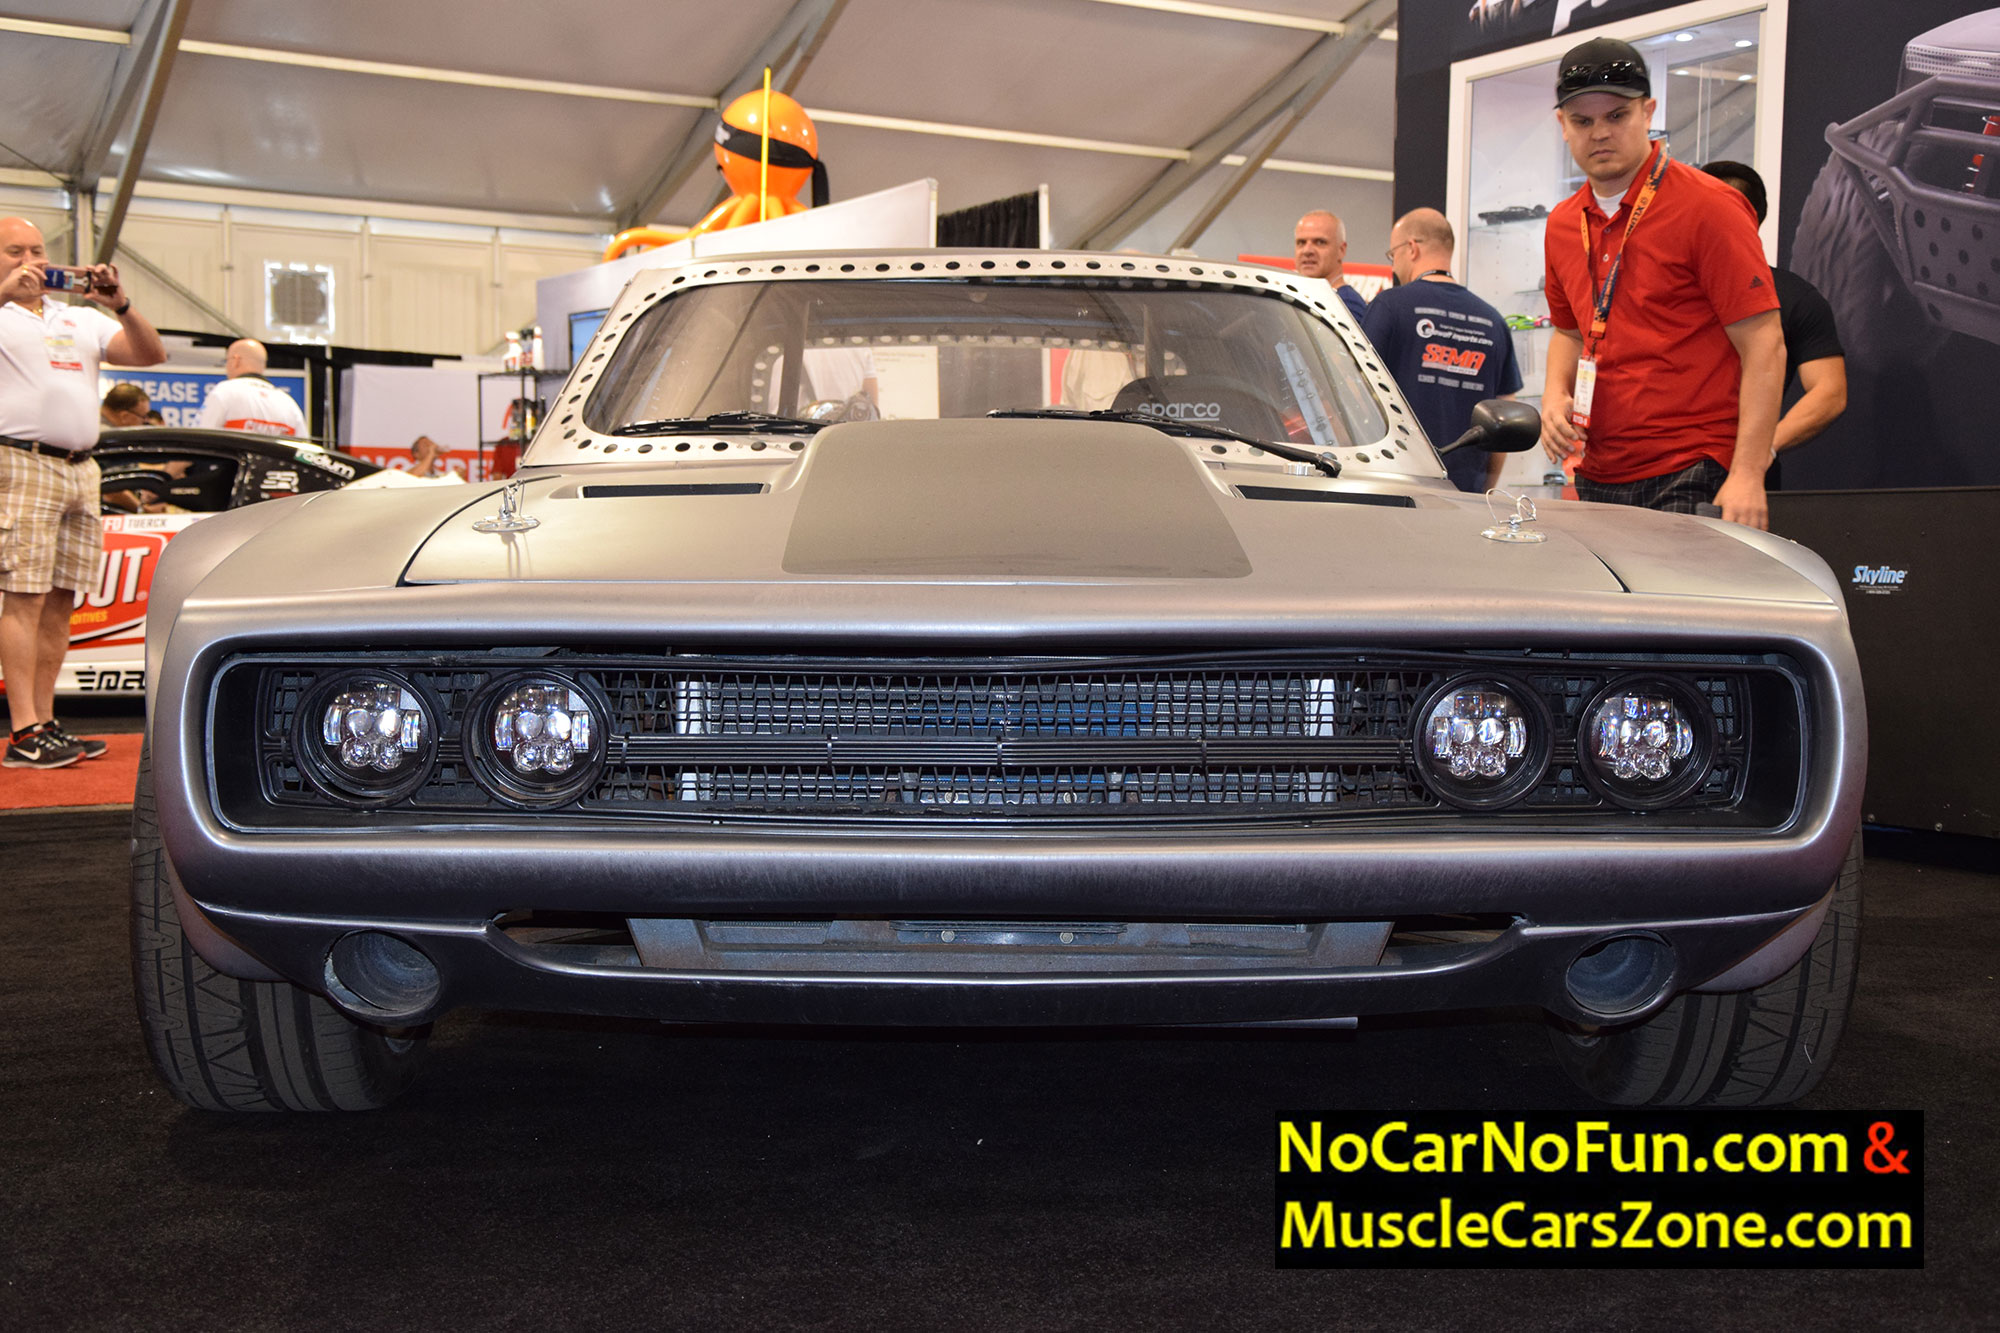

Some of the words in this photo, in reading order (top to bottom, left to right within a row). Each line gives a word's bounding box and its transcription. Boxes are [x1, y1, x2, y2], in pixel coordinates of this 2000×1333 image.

[1422, 343, 1486, 370] SEMA
[295, 449, 356, 480] radium
[73, 546, 151, 609] UT
[1852, 565, 1906, 586] Skyline
